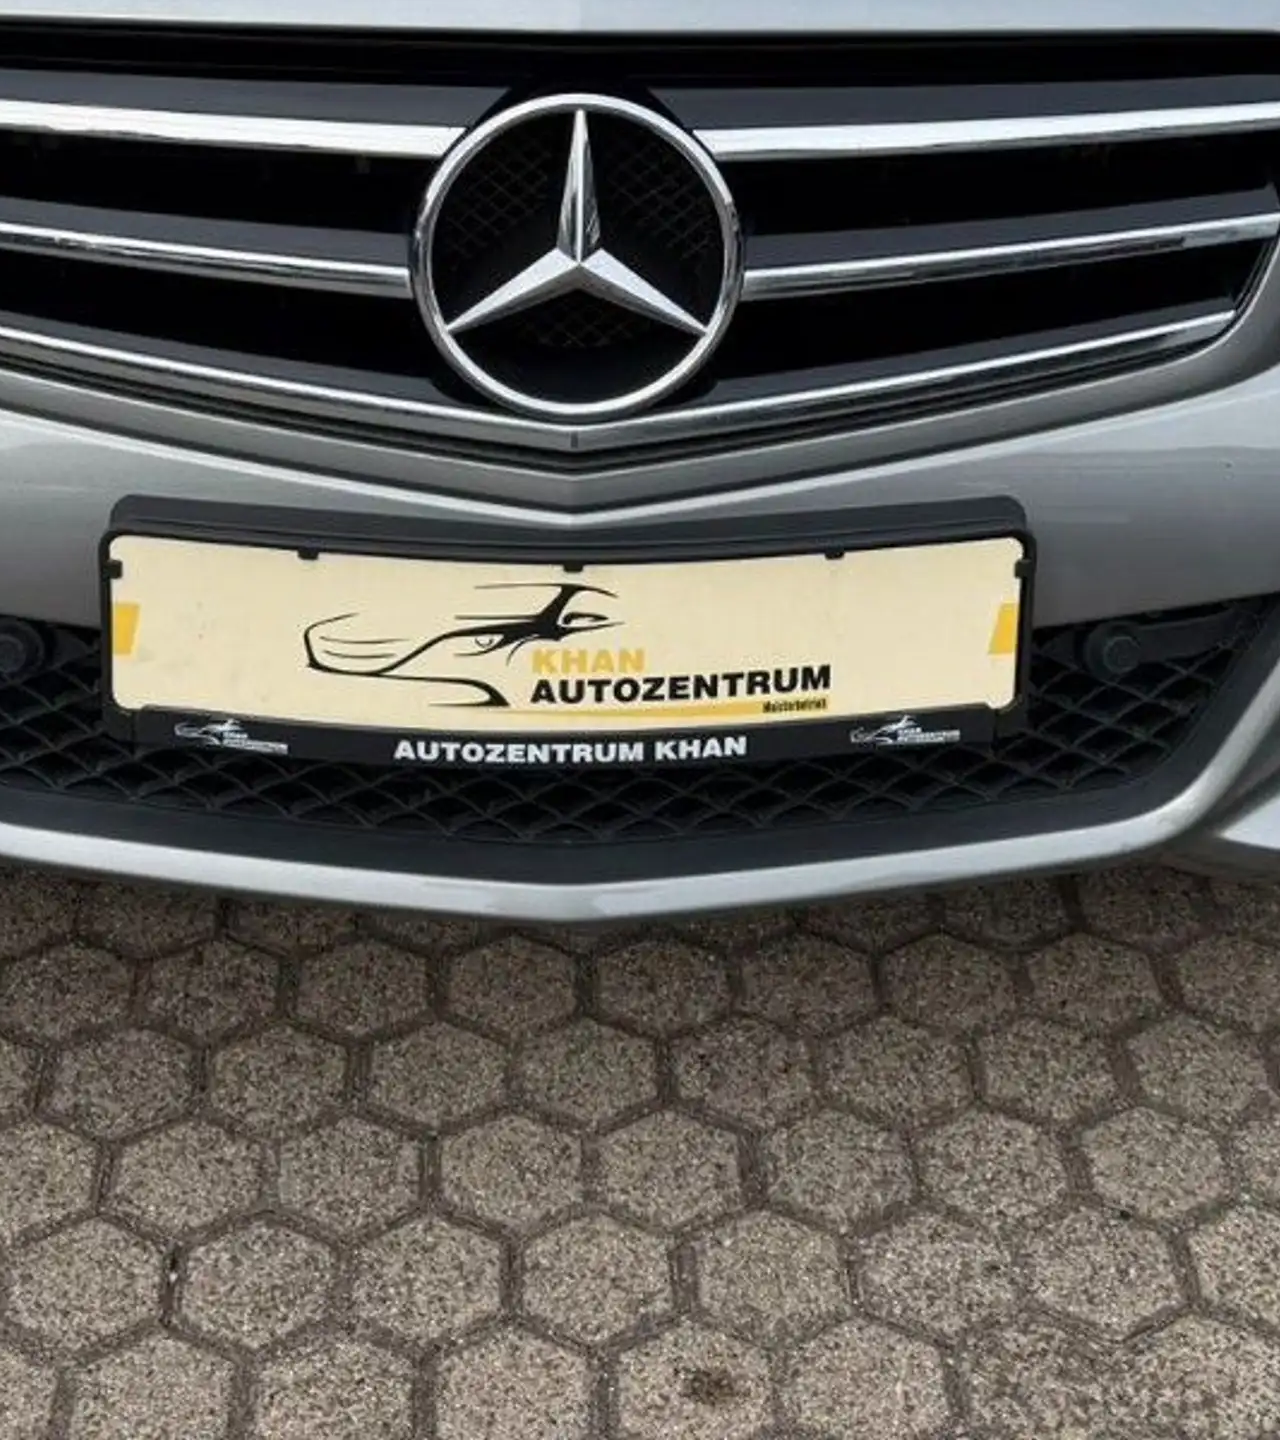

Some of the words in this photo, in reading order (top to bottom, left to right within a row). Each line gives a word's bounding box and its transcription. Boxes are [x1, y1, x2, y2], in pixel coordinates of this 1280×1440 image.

[531, 648, 646, 674] KHAN
[530, 663, 831, 704] AUTOZENTRUM
[393, 739, 645, 764] AUTOZENTRUM
[654, 736, 747, 760] KHAN
